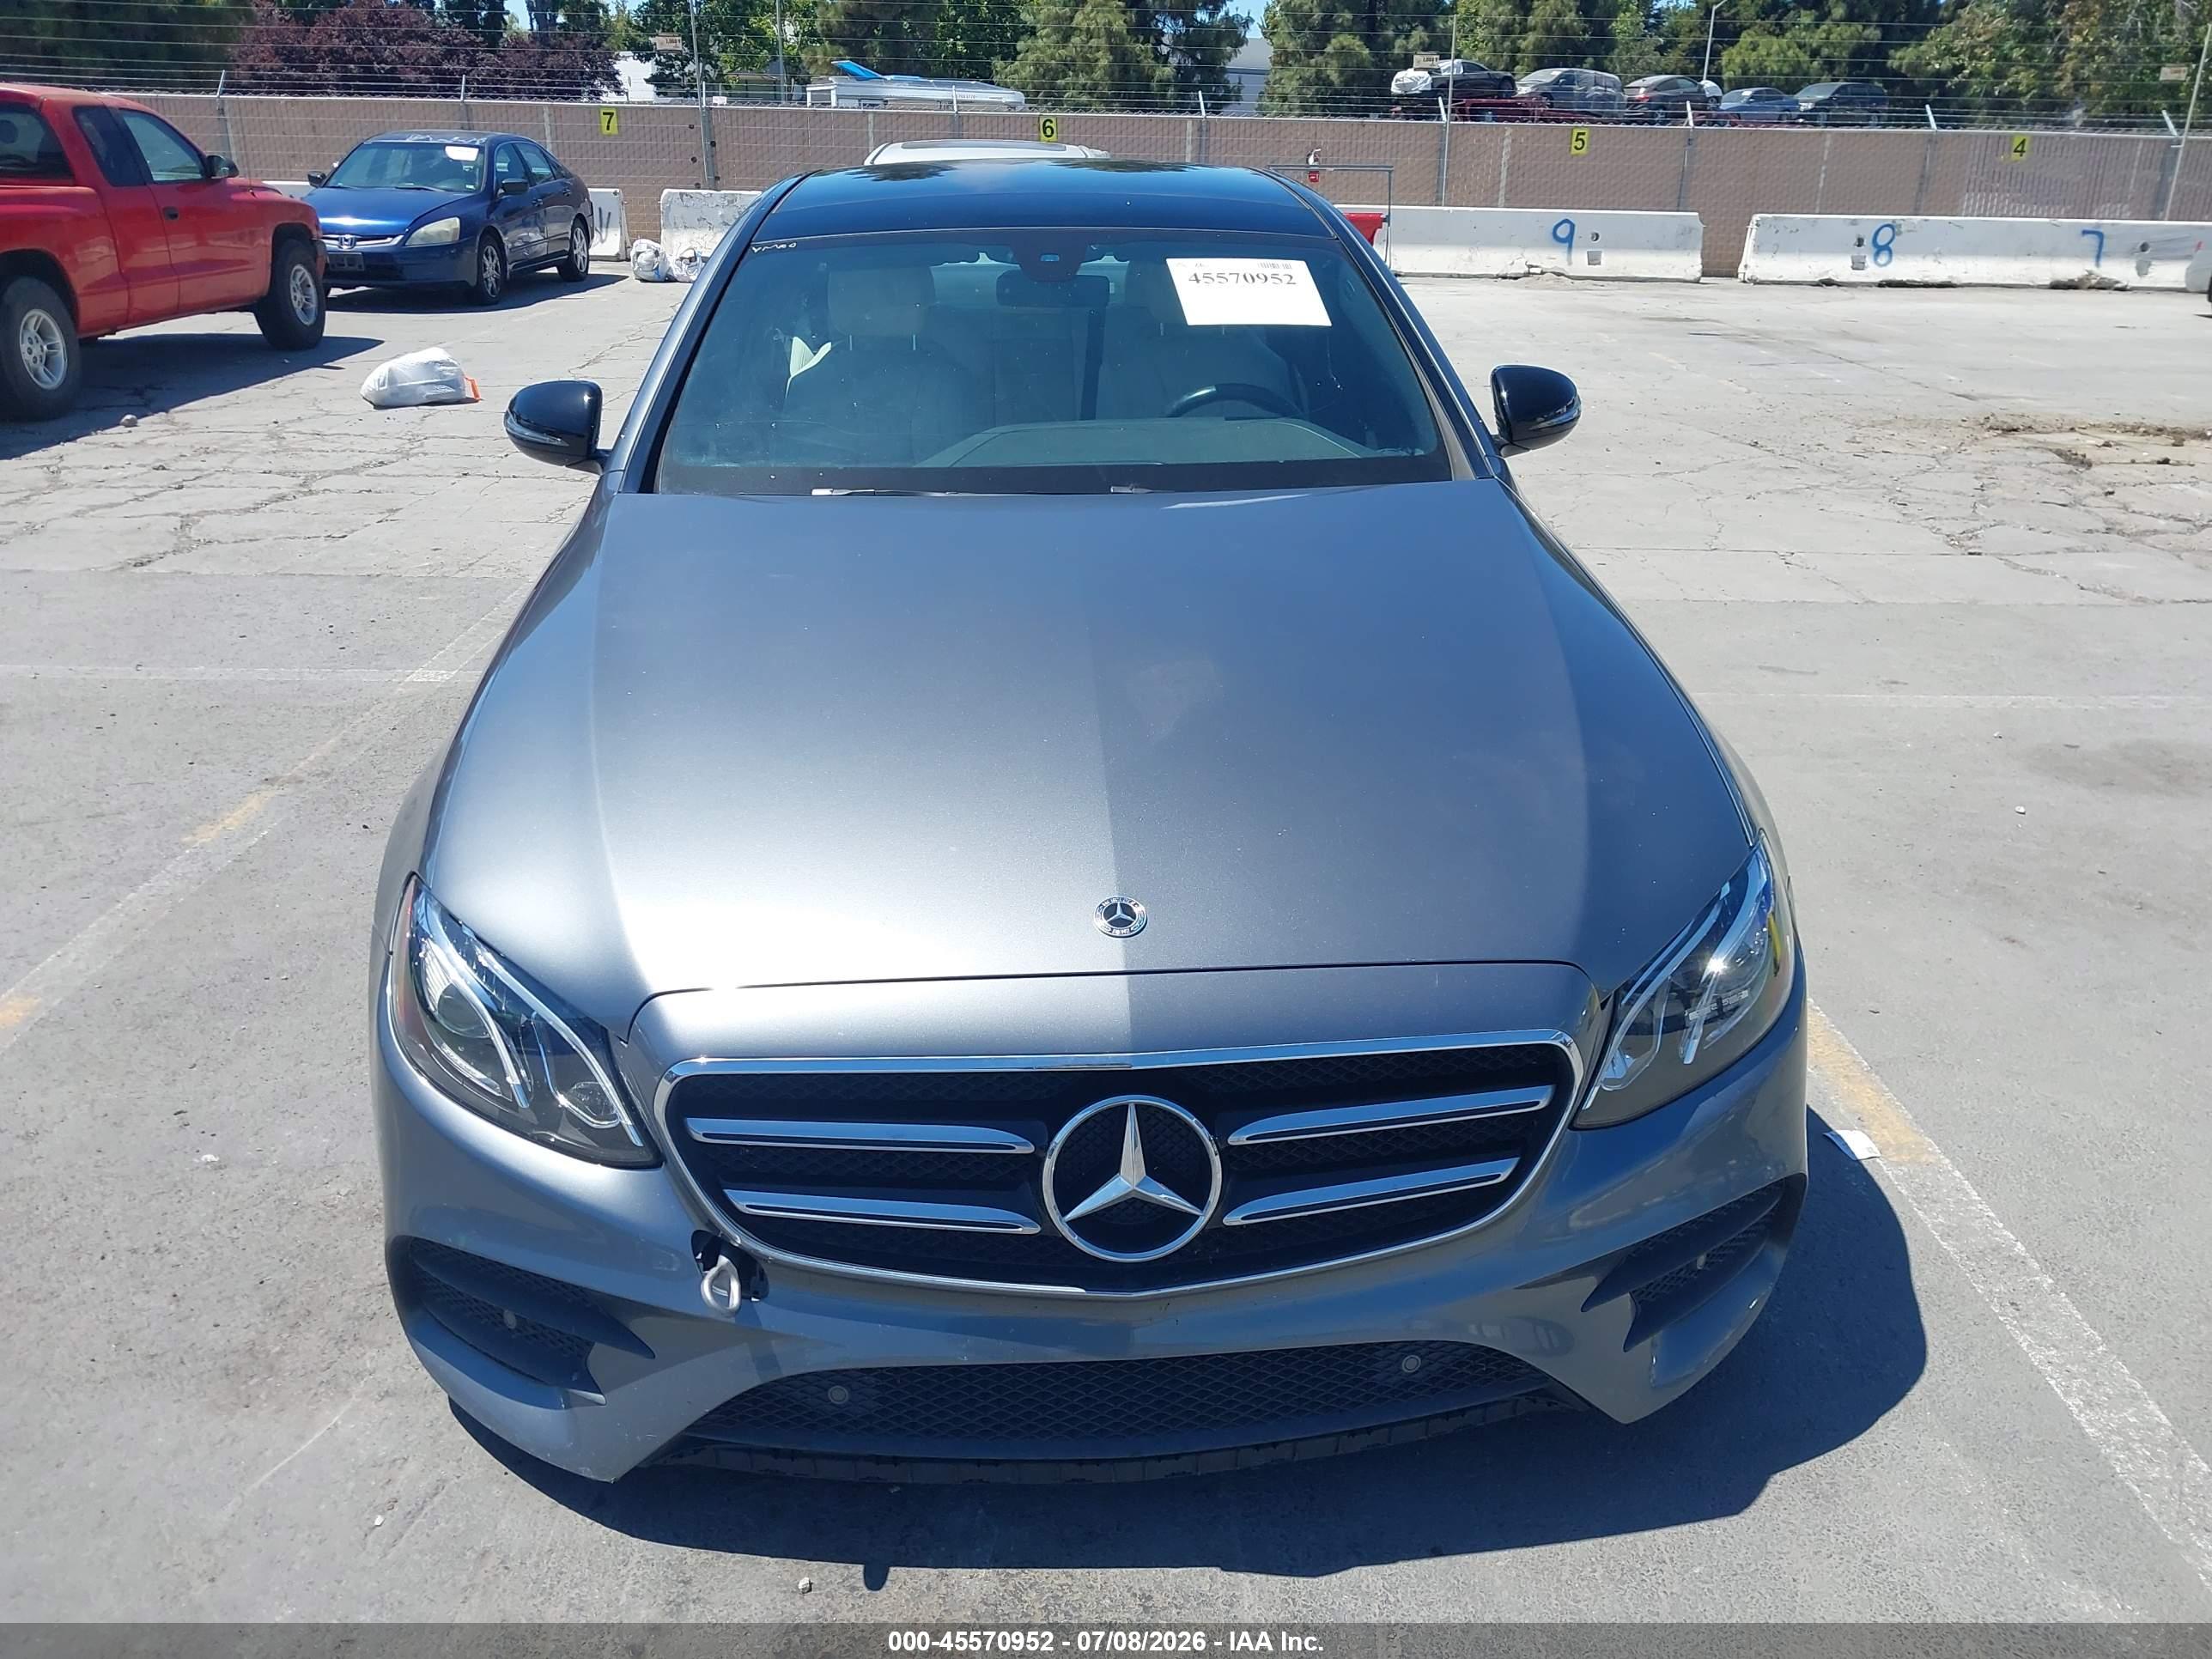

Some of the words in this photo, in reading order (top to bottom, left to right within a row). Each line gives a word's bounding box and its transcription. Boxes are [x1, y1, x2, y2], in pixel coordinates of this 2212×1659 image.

[603, 112, 614, 131] 7
[1042, 118, 1054, 138] 6
[1573, 132, 1586, 151] 5
[2014, 138, 2026, 157] 4
[1553, 218, 1576, 266] 9
[1872, 223, 1896, 268] 8
[2081, 229, 2104, 267] 7
[1188, 272, 1297, 285] 45570952
